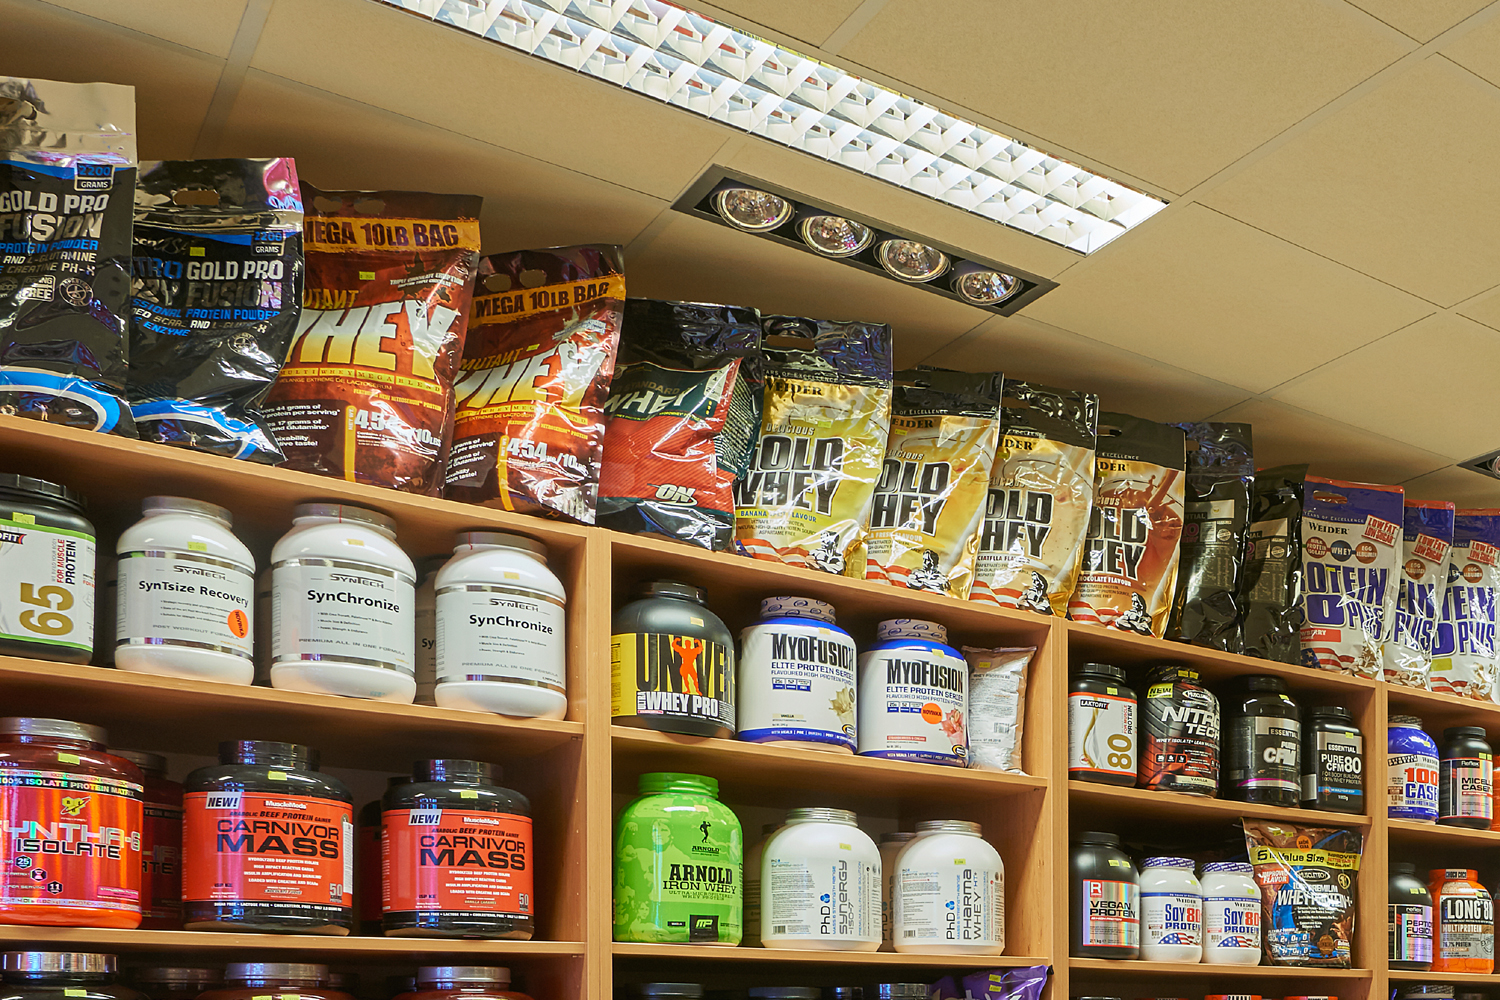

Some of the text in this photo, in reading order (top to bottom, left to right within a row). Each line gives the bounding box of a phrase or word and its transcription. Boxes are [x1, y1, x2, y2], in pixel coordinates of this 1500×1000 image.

[80, 180, 108, 188] GRAMS
[64, 194, 109, 213] PRO
[361, 223, 459, 247] 10LB BAG
[187, 260, 284, 280] GOLD PRO
[476, 281, 609, 319] MEGA 10LB BAG
[766, 423, 815, 437] DELICIOUS
[1309, 521, 1348, 536] WEIDER
[65, 539, 76, 586] PROTEIN
[138, 580, 250, 607] SynTsize Recovery
[307, 589, 400, 614] SynChronize
[20, 581, 75, 637] 65
[468, 613, 554, 635] SynChronize
[1458, 621, 1495, 657] PLUS
[771, 661, 833, 676] ELITE PROTEIN
[886, 685, 942, 699] ELITE PROTEIN
[648, 692, 719, 719] WHEY PRO
[1107, 733, 1132, 770] 80
[207, 796, 239, 809] NEW!
[410, 812, 441, 825] NEW!
[217, 819, 339, 841] CARNIVOR
[16, 839, 121, 860] ISOLATE
[217, 834, 339, 859] MASS
[419, 835, 526, 855] CARNIVOR
[420, 848, 525, 871] MASS
[668, 863, 733, 885] ARNOLD
[663, 880, 737, 895] IRON WHEY
[1090, 901, 1131, 910] VEGAN
[1090, 909, 1136, 918] PROTEIN
[820, 903, 830, 936] PhD
[945, 910, 955, 940] PhD
[1443, 924, 1482, 933] MULTIPROTEIN
